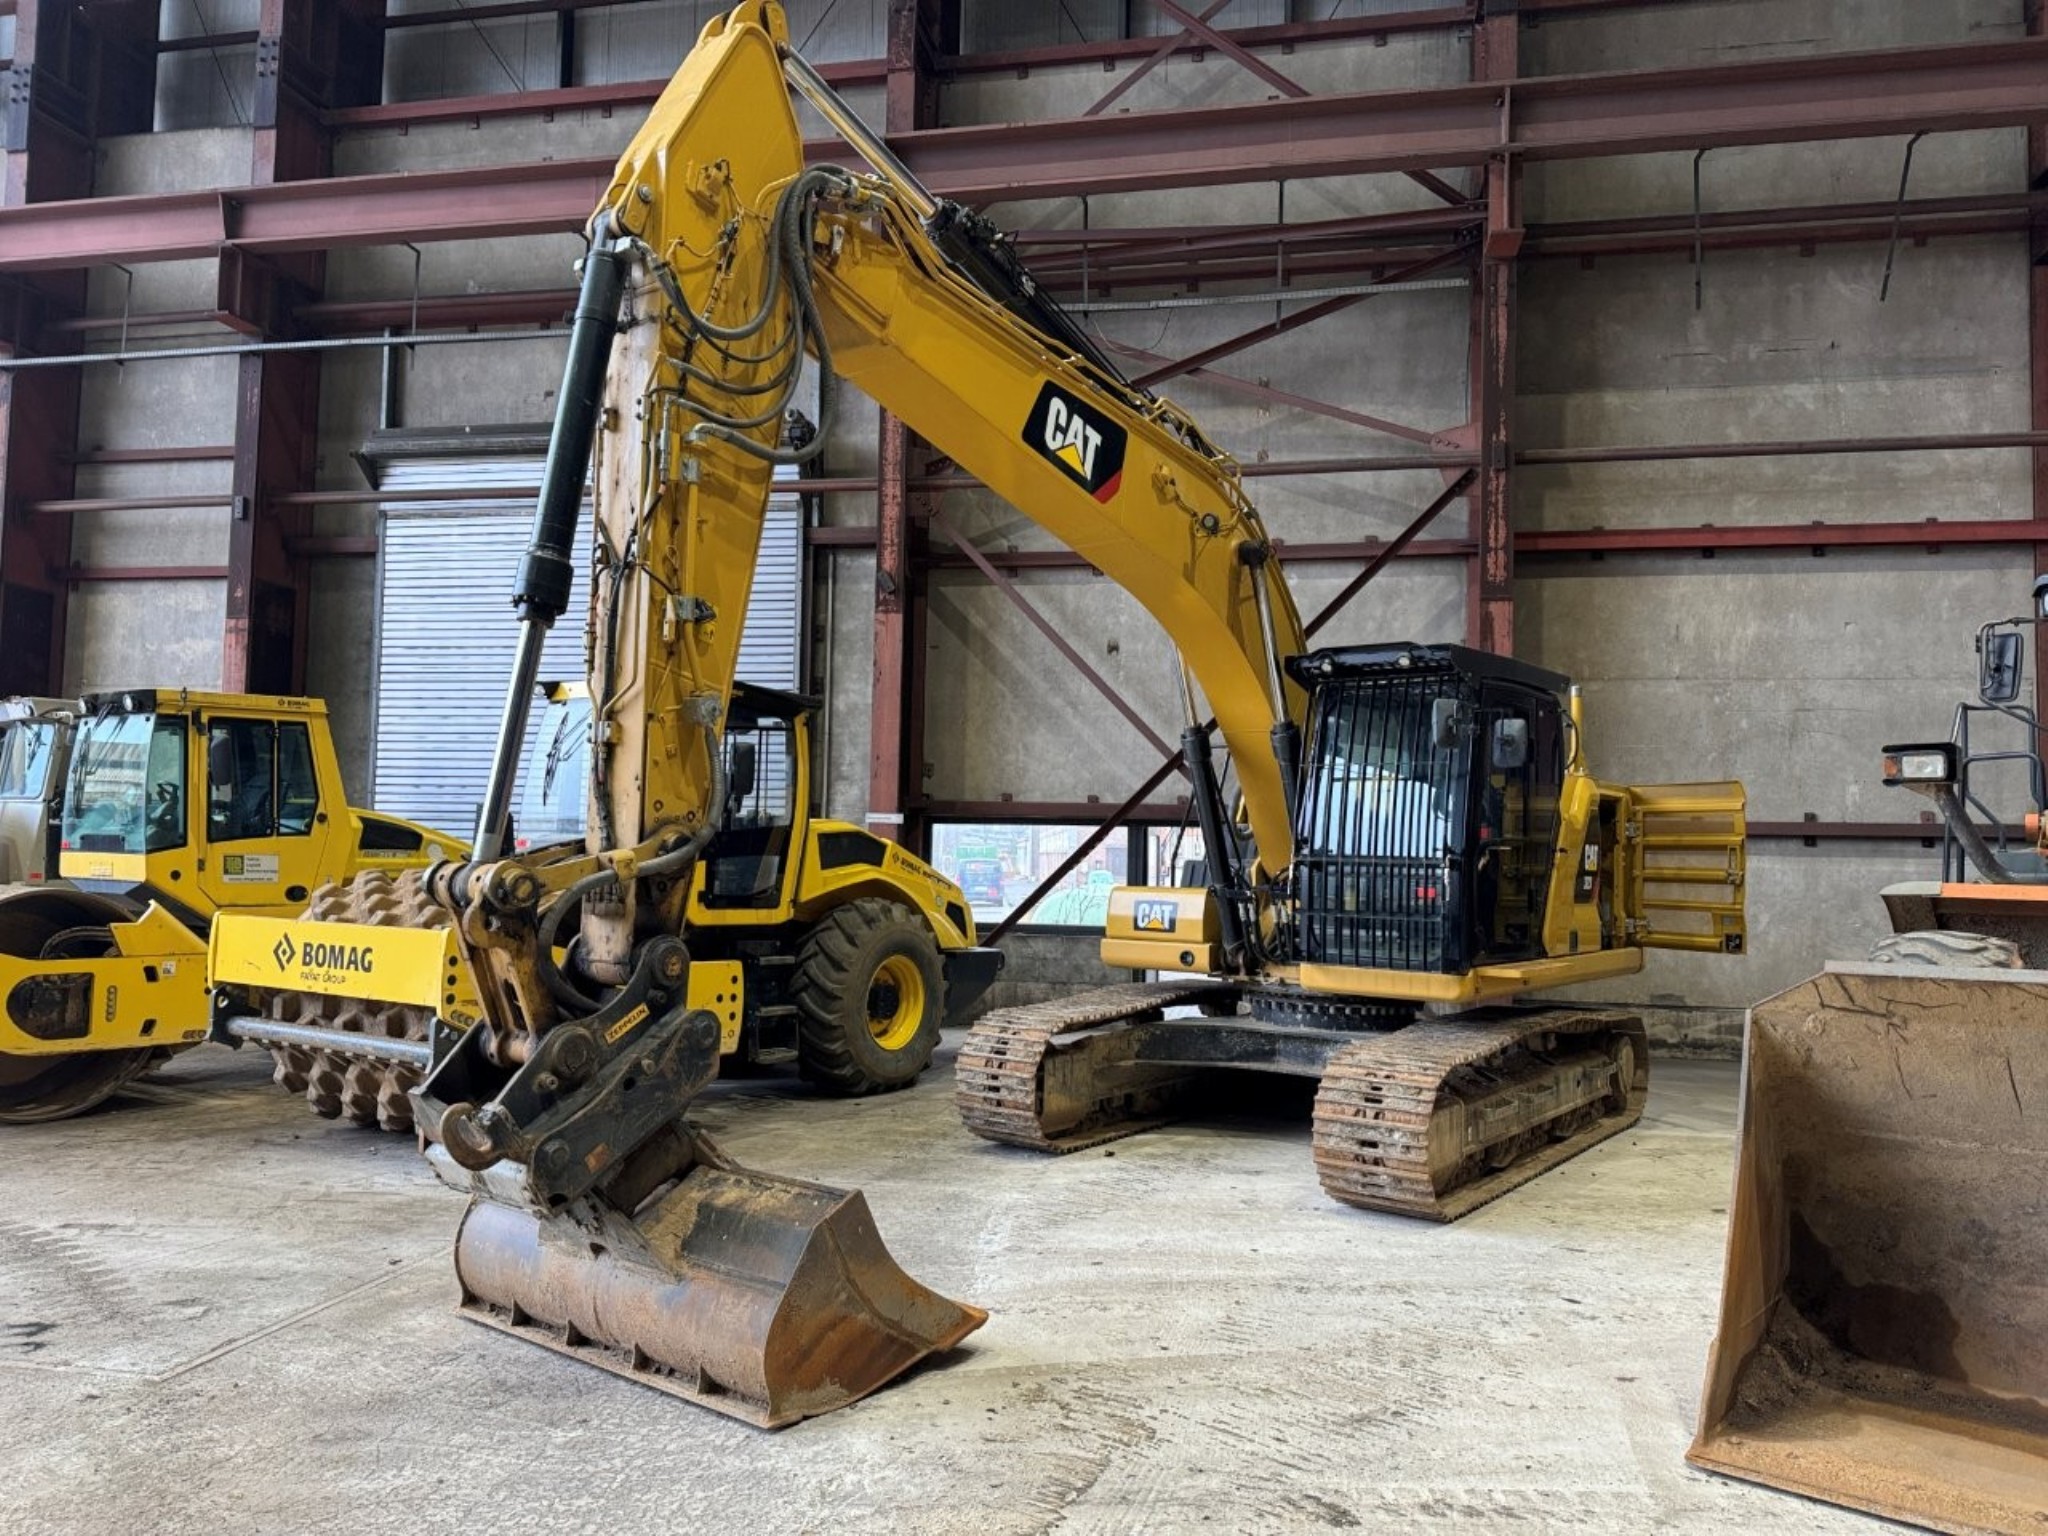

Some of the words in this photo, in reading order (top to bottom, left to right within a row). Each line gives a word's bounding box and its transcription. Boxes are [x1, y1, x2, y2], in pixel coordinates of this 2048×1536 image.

[1045, 397, 1102, 481] CAT
[1136, 903, 1173, 930] CAT
[302, 941, 373, 973] BOMAG
[607, 1007, 646, 1039] ZEPPELIN
